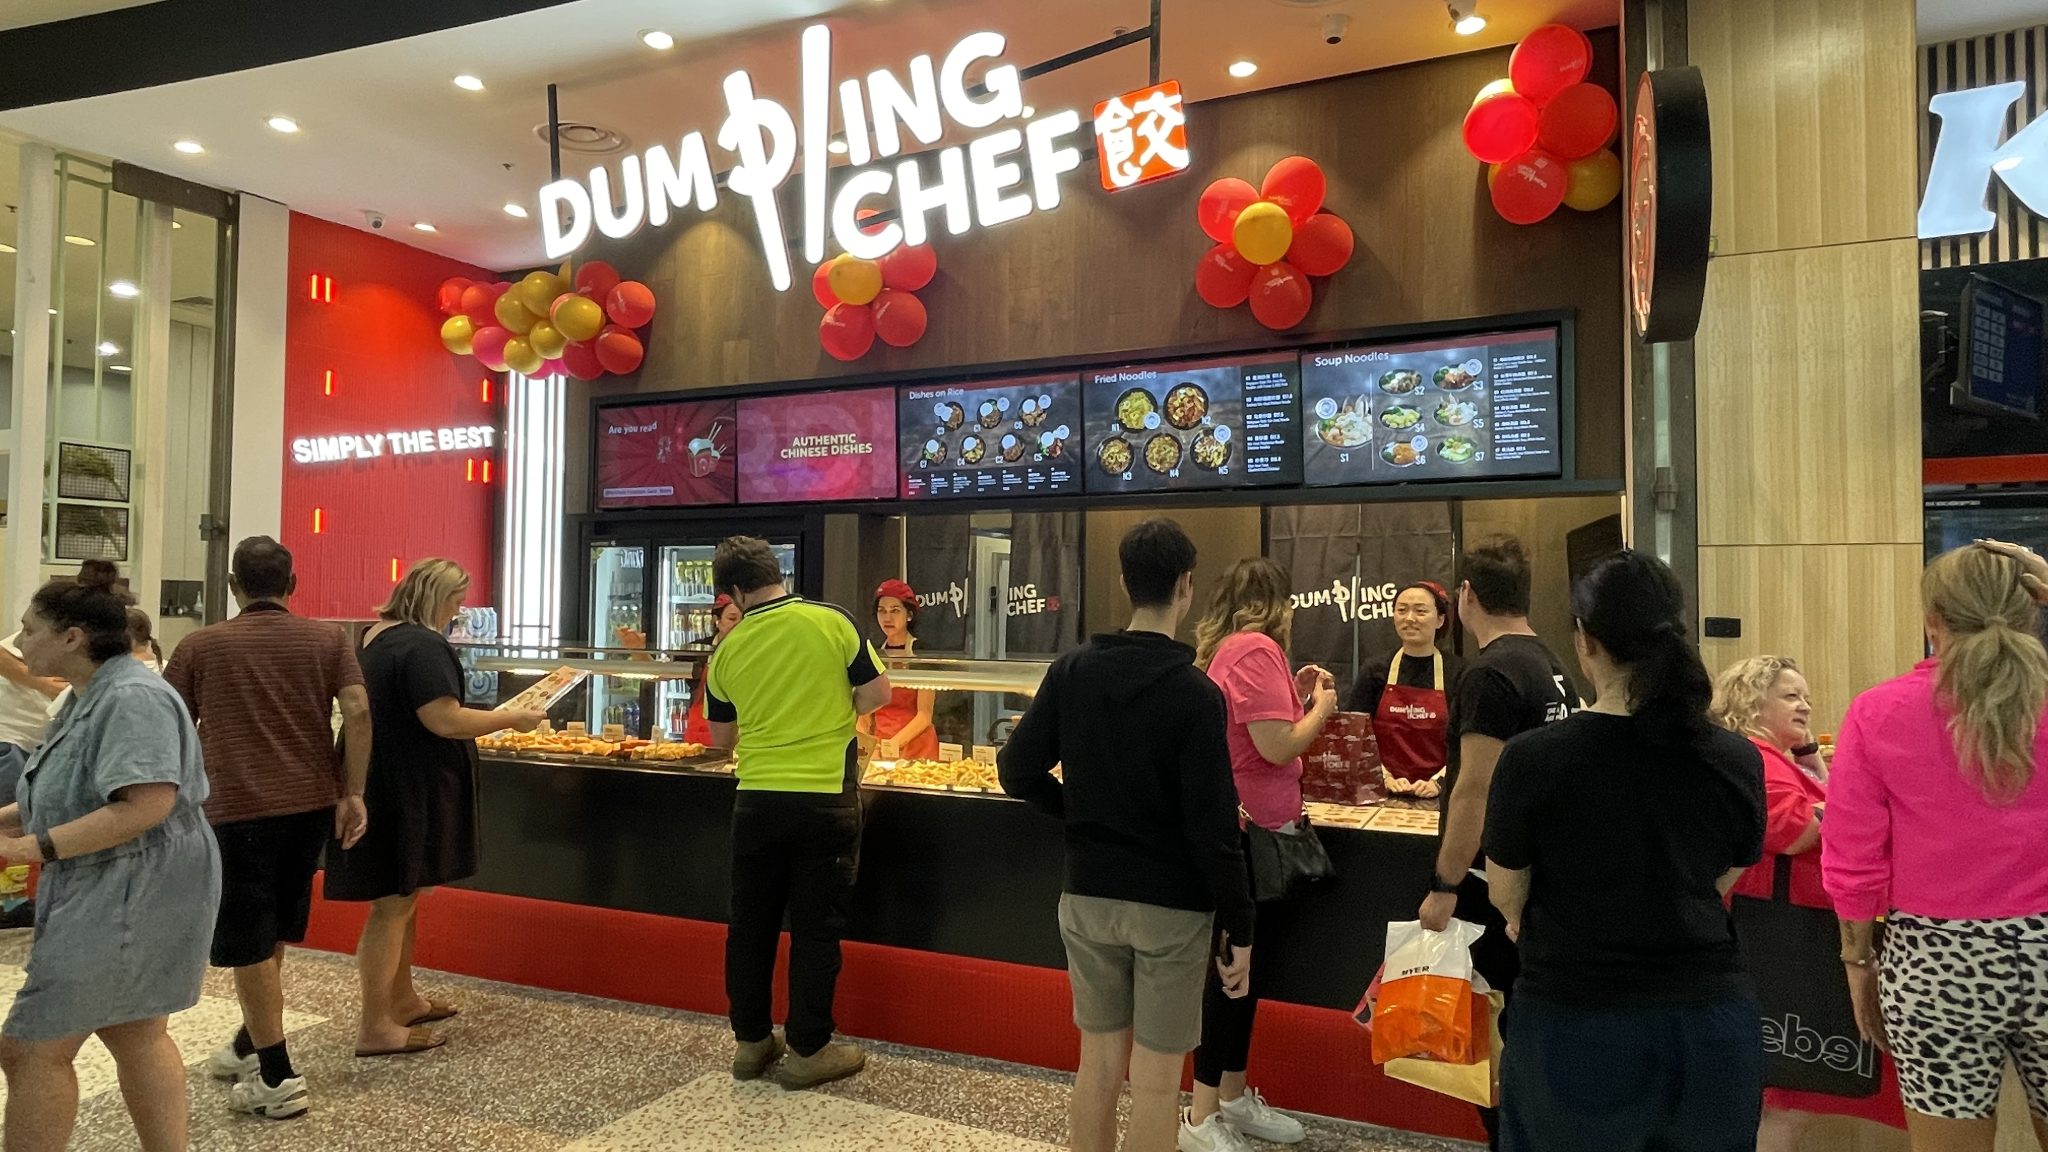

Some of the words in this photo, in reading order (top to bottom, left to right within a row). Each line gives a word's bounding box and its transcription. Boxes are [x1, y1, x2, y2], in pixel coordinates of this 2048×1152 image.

[830, 109, 1081, 260] CHEF
[1314, 355, 1343, 367] Soup
[1344, 351, 1390, 364] Noodles
[1094, 373, 1117, 384] Fried
[1118, 370, 1157, 381] Noodles
[1414, 386, 1425, 396] S2
[1472, 381, 1484, 391] S3
[909, 390, 934, 400] Dishes
[935, 390, 946, 398] on
[947, 387, 964, 396] Rice
[1202, 415, 1211, 425] N2
[1473, 419, 1484, 428] S5
[608, 425, 622, 435] Are
[624, 425, 639, 435] you
[1111, 423, 1120, 432] N1
[1414, 423, 1425, 433] S4
[292, 433, 384, 463] SIMPLY
[387, 430, 436, 454] THE
[438, 426, 495, 450] BEST
[792, 433, 857, 447] AUTHENTIC
[780, 446, 828, 459] CHINESE
[831, 443, 873, 455] DISHES
[957, 457, 966, 466] C4
[995, 456, 1004, 464] C2
[1033, 453, 1043, 462] C5
[1340, 453, 1349, 463] S1
[1474, 451, 1485, 462] S7
[1169, 469, 1179, 478] N4
[1218, 466, 1229, 475] N5
[1007, 598, 1046, 617] CHEF
[1760, 1013, 1875, 1079] ebel
